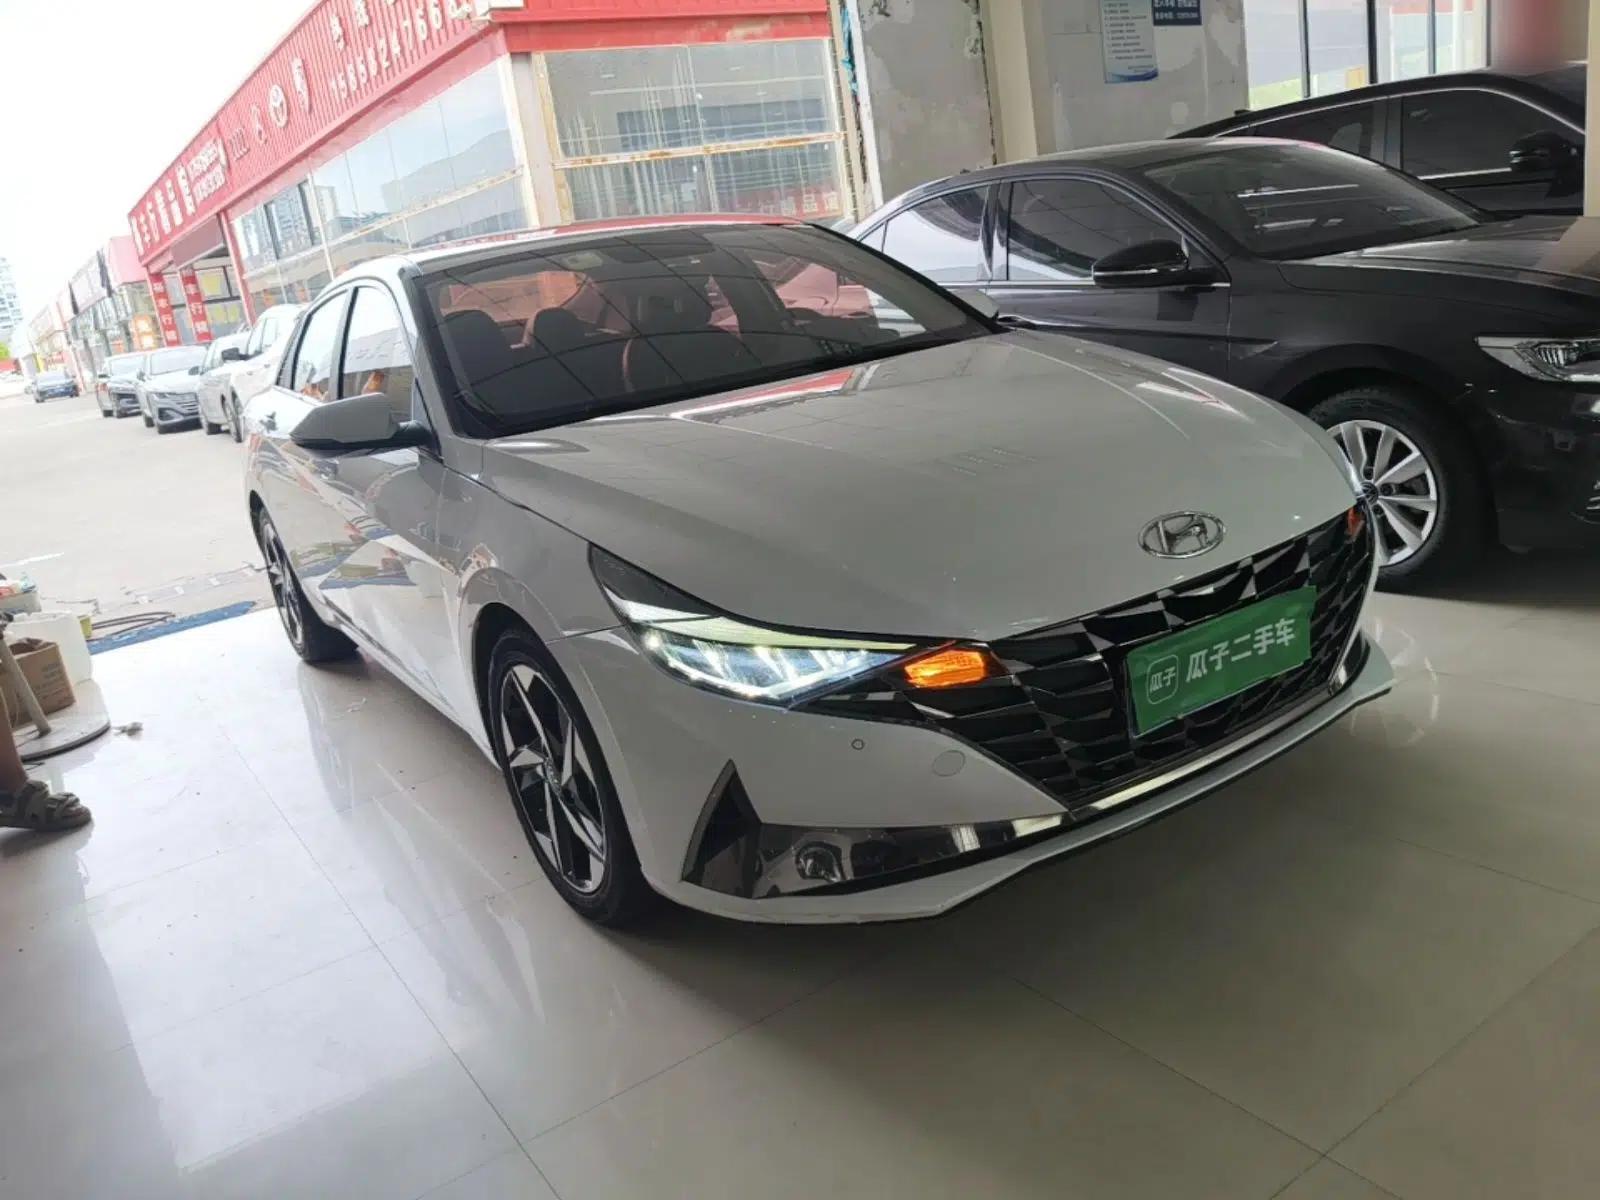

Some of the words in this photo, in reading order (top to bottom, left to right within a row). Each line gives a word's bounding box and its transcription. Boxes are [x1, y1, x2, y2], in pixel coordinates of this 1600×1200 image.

[1185, 617, 1296, 684] 瓜子二手车
[1149, 666, 1177, 692] 瓜子
